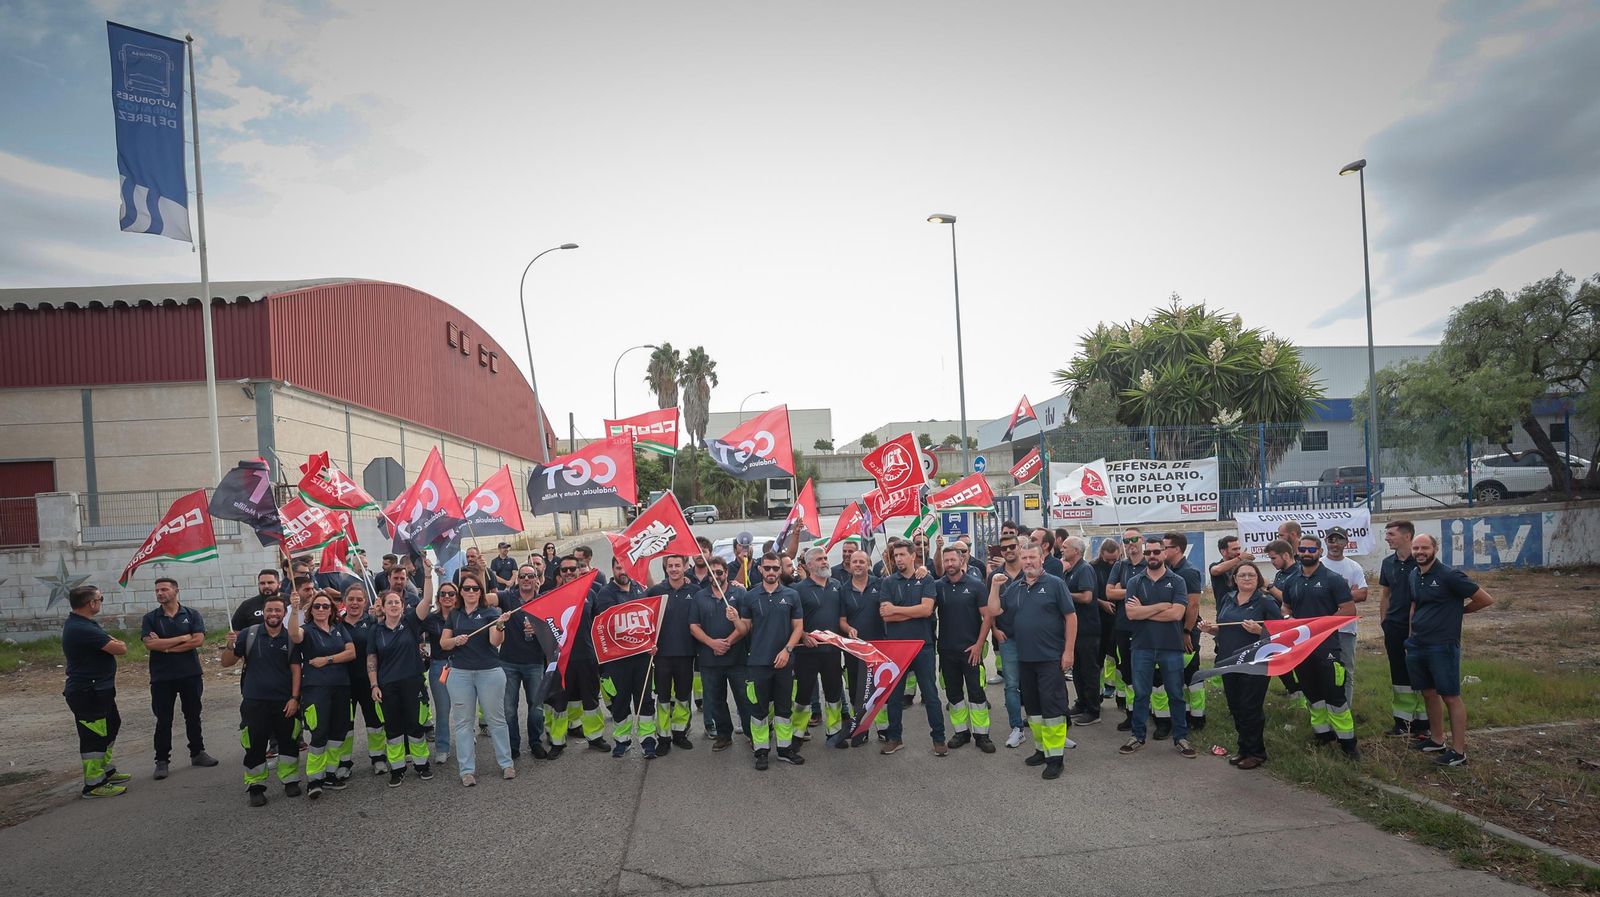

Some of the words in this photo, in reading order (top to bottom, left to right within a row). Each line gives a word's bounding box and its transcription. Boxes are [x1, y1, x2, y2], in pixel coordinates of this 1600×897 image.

[1172, 461, 1191, 469] DE
[1140, 471, 1203, 481] SALARIO,
[1117, 483, 1172, 494] EMPLEO
[1177, 482, 1186, 491] Y
[1157, 492, 1217, 504] PÚBLICO
[1258, 513, 1314, 522] CONVENIO
[1318, 511, 1352, 520] JUSTO
[1451, 519, 1532, 566] itv
[614, 610, 650, 633] UGT
